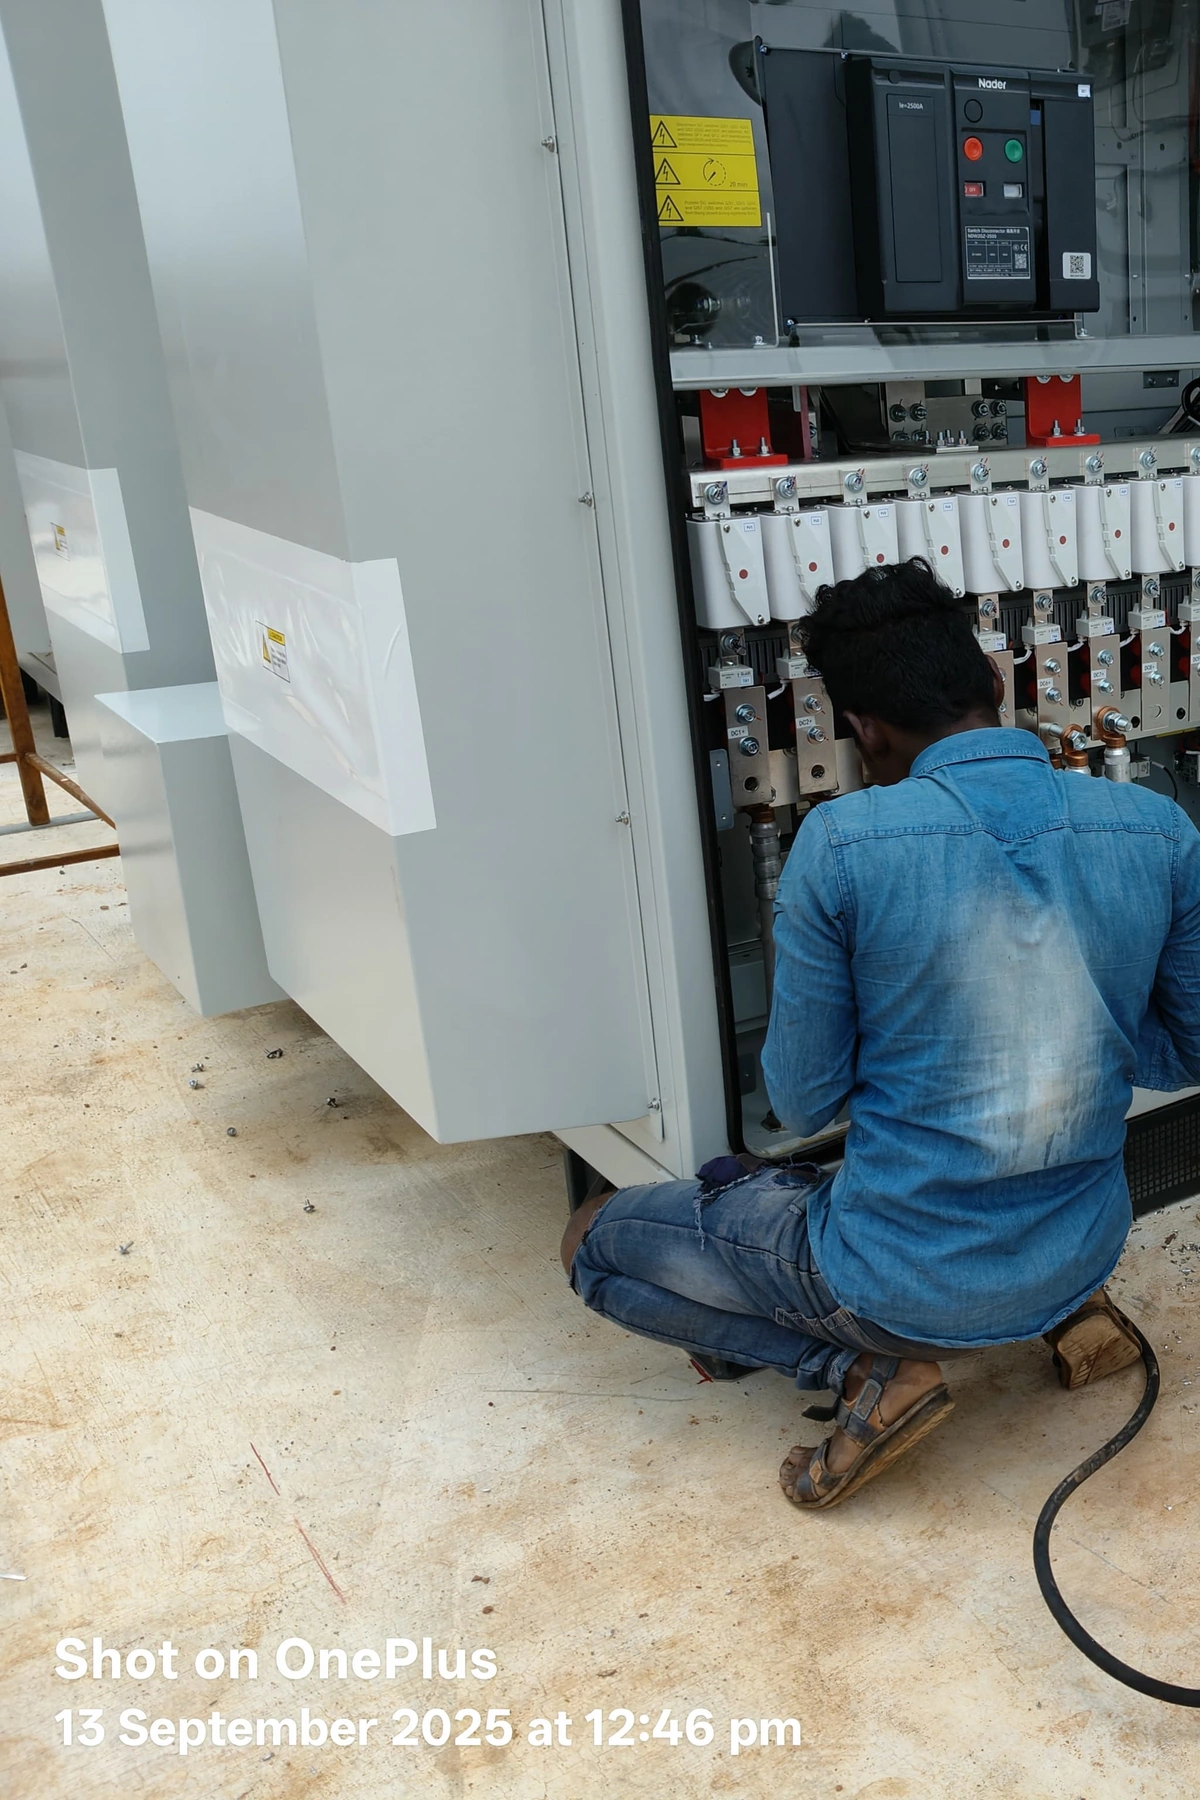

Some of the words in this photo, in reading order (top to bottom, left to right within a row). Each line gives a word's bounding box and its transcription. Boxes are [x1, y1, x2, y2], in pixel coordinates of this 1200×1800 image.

[978, 77, 1007, 90] Nader
[798, 718, 812, 726] DC2+
[730, 729, 745, 737] DC1+
